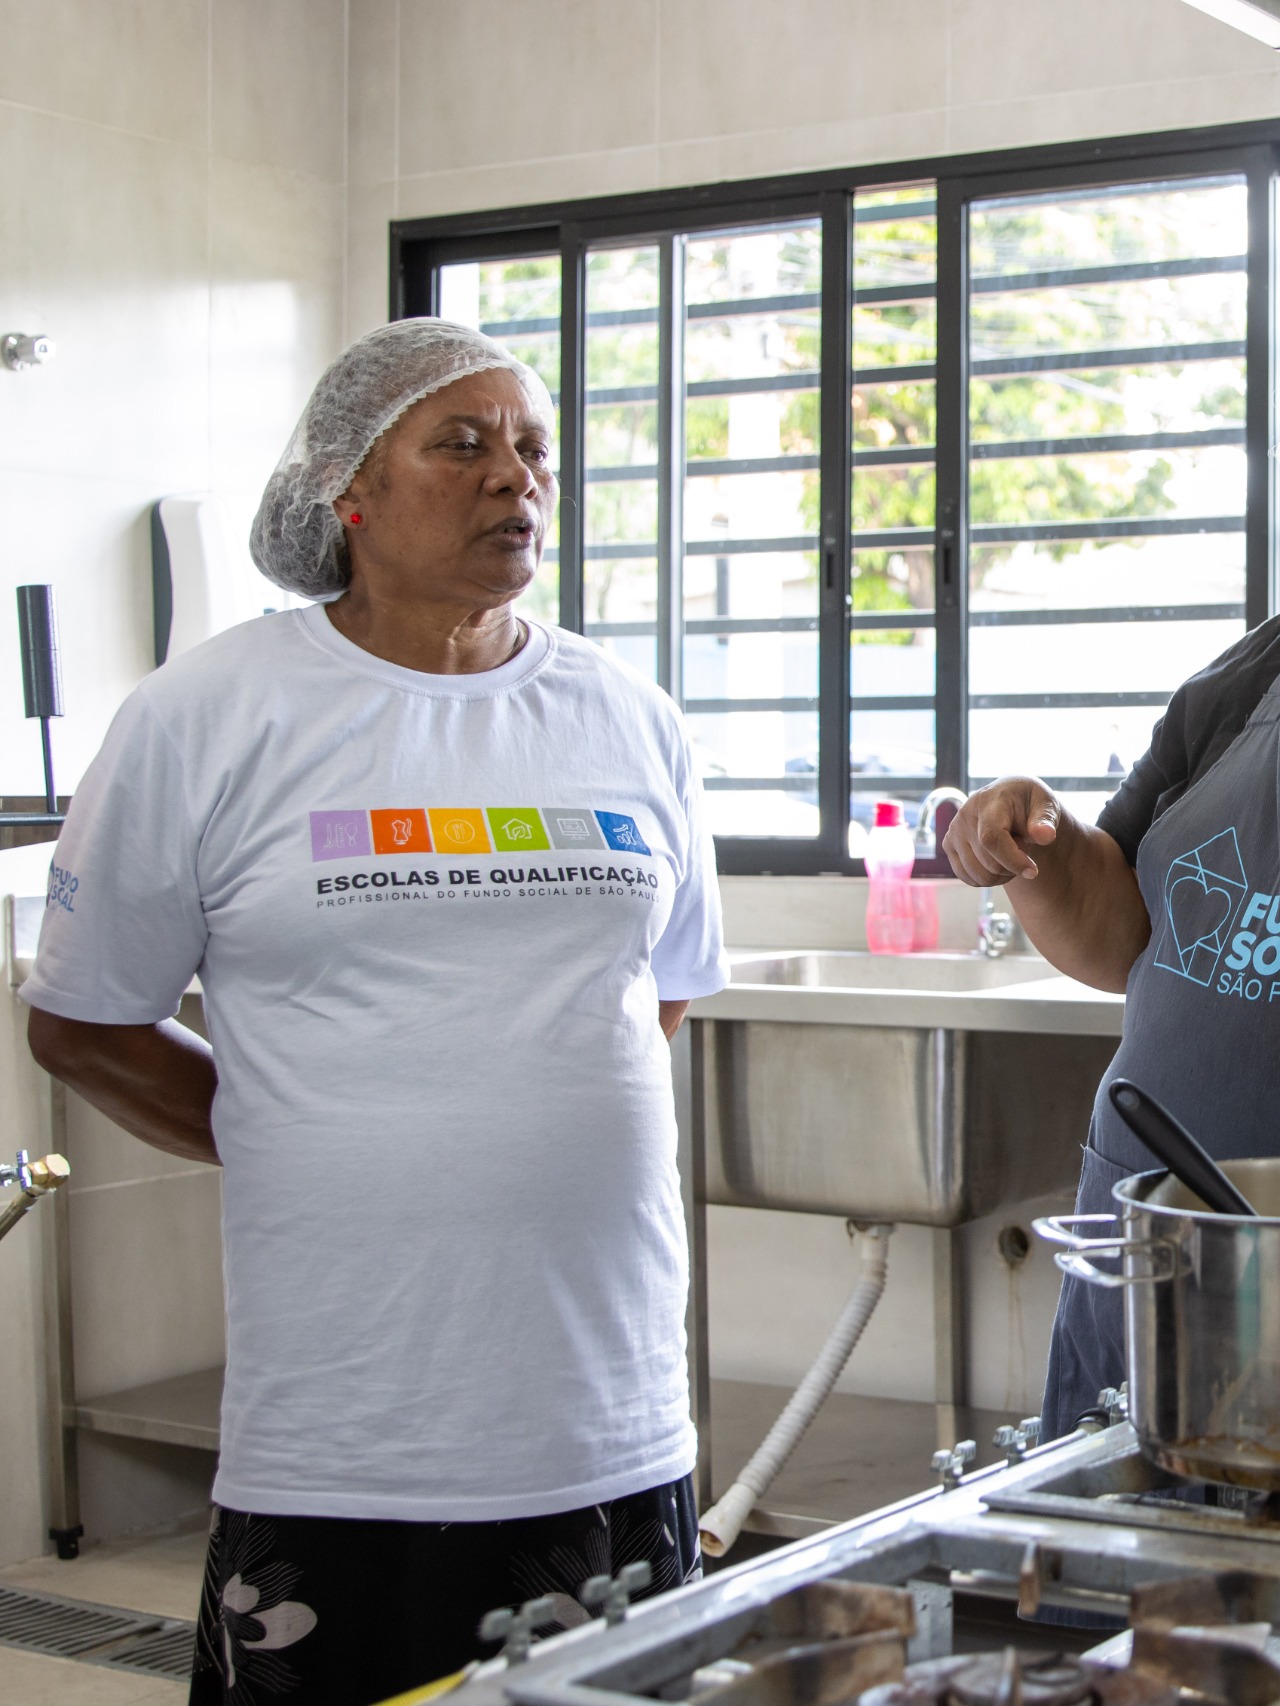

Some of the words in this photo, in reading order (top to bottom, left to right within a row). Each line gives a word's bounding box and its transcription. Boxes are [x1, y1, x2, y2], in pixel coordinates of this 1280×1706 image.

[316, 869, 440, 895] ESCOLAS
[448, 869, 482, 885] DE
[489, 866, 659, 889] QUALIFICAÇÃO
[316, 891, 430, 909] PROFISSIONAL
[437, 890, 456, 899] DO
[464, 889, 512, 899] FUNDO
[518, 887, 568, 897] SOCIAL
[575, 886, 592, 895] DE
[599, 885, 625, 896] SÃO
[1216, 971, 1263, 1001] SÃO
